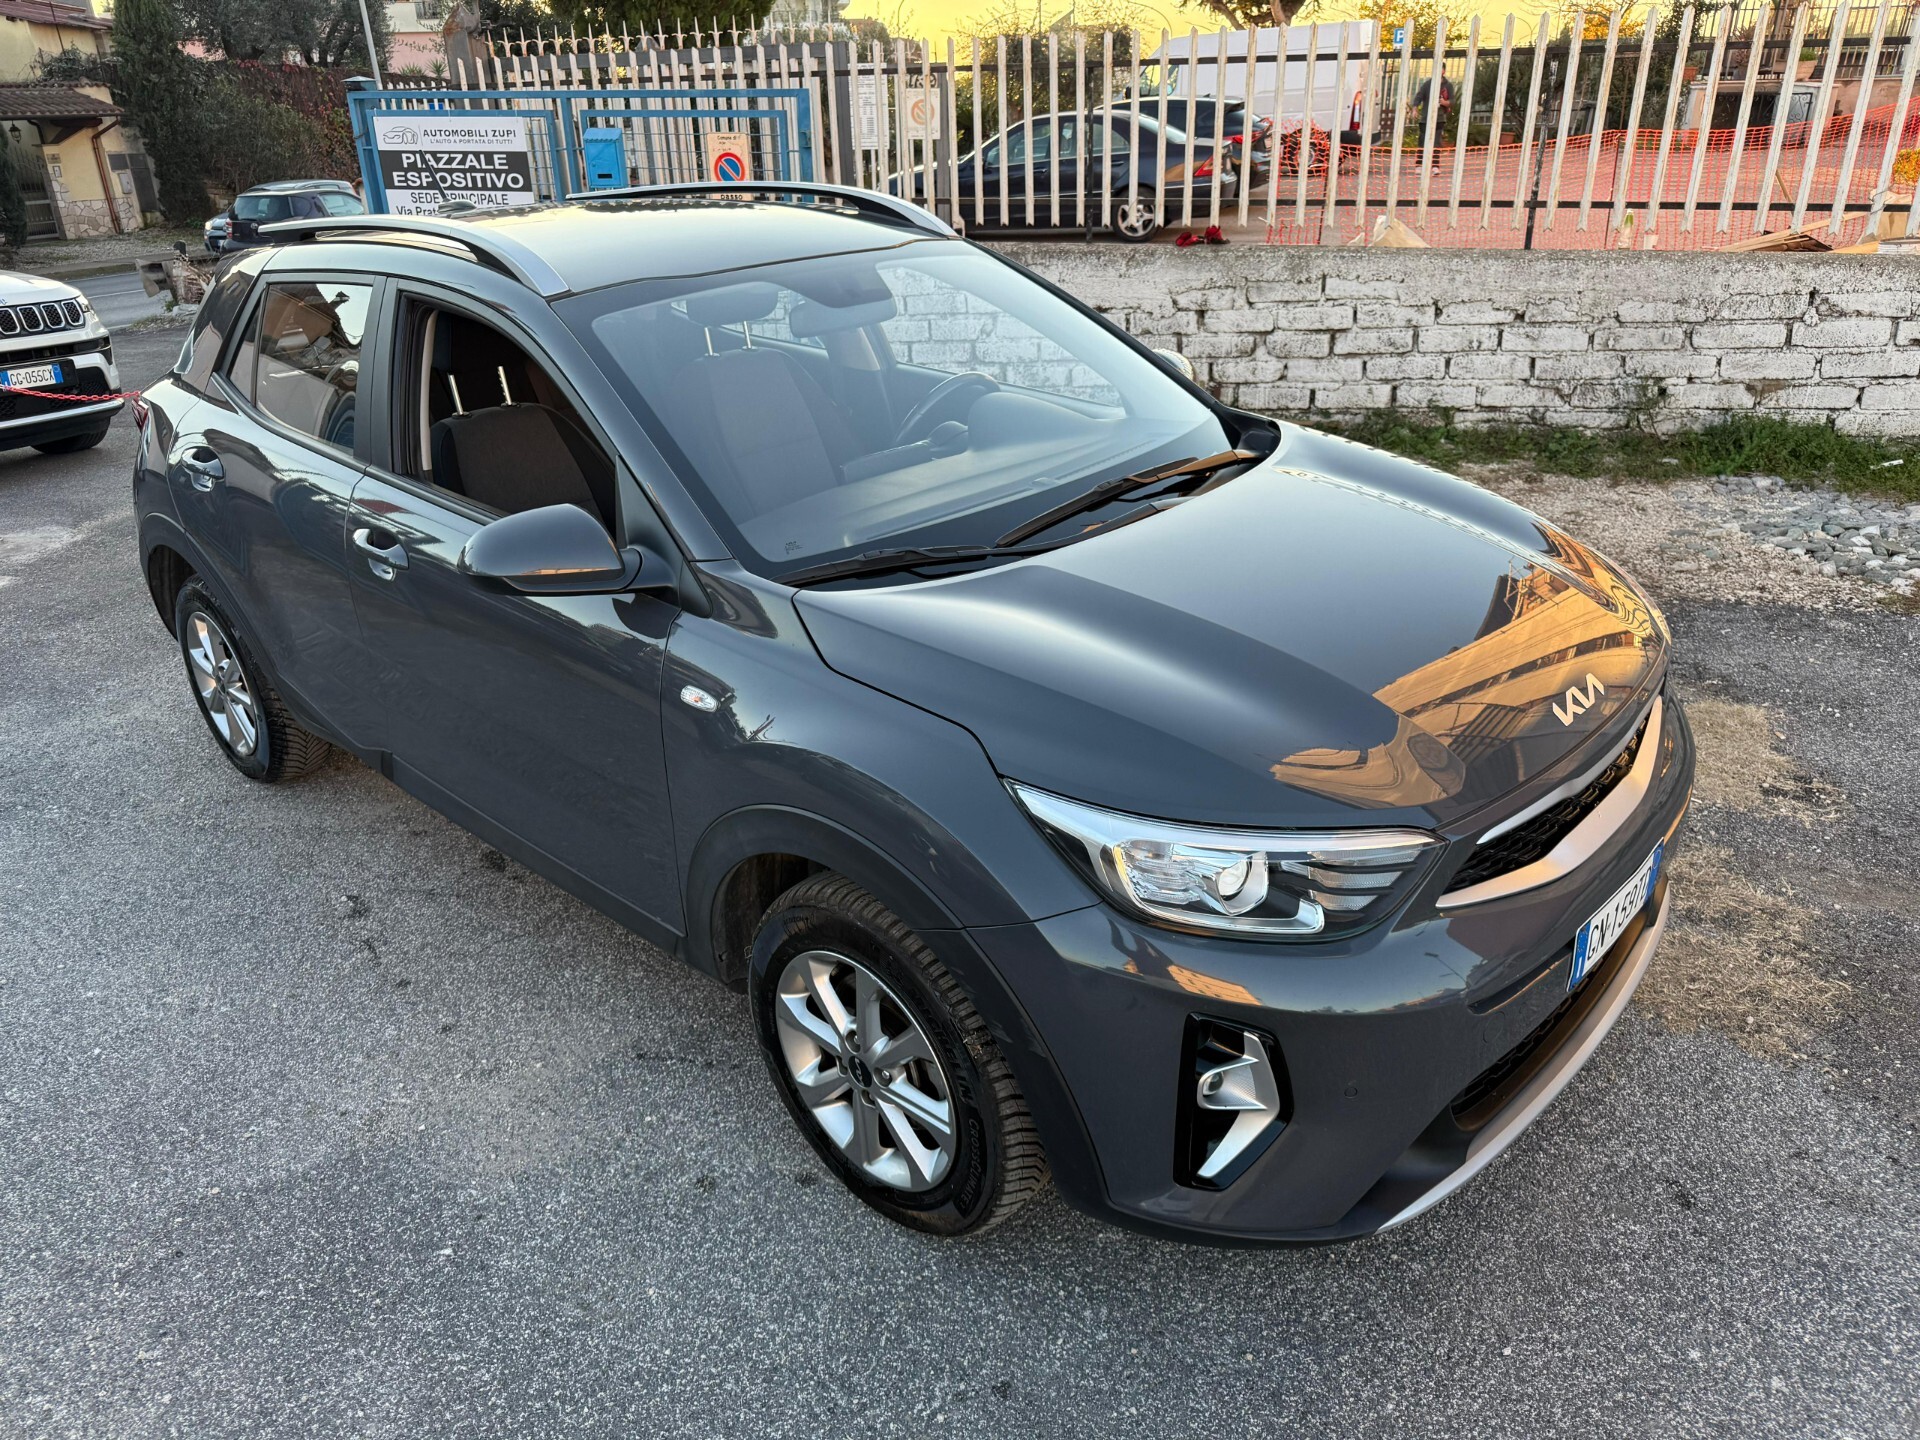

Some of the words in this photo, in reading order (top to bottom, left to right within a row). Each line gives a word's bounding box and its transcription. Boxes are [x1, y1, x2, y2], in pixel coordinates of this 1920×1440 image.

[423, 129, 488, 137] AUTOMOBILI
[491, 129, 516, 138] ZUPI
[402, 153, 509, 169] PIAZZALE
[392, 171, 524, 189] ESPOSITIVO
[410, 192, 440, 204] SEDE
[446, 193, 509, 206] RINCIPALE
[396, 205, 413, 215] Via
[415, 206, 437, 216] Prat
[1552, 672, 1605, 727] KIA
